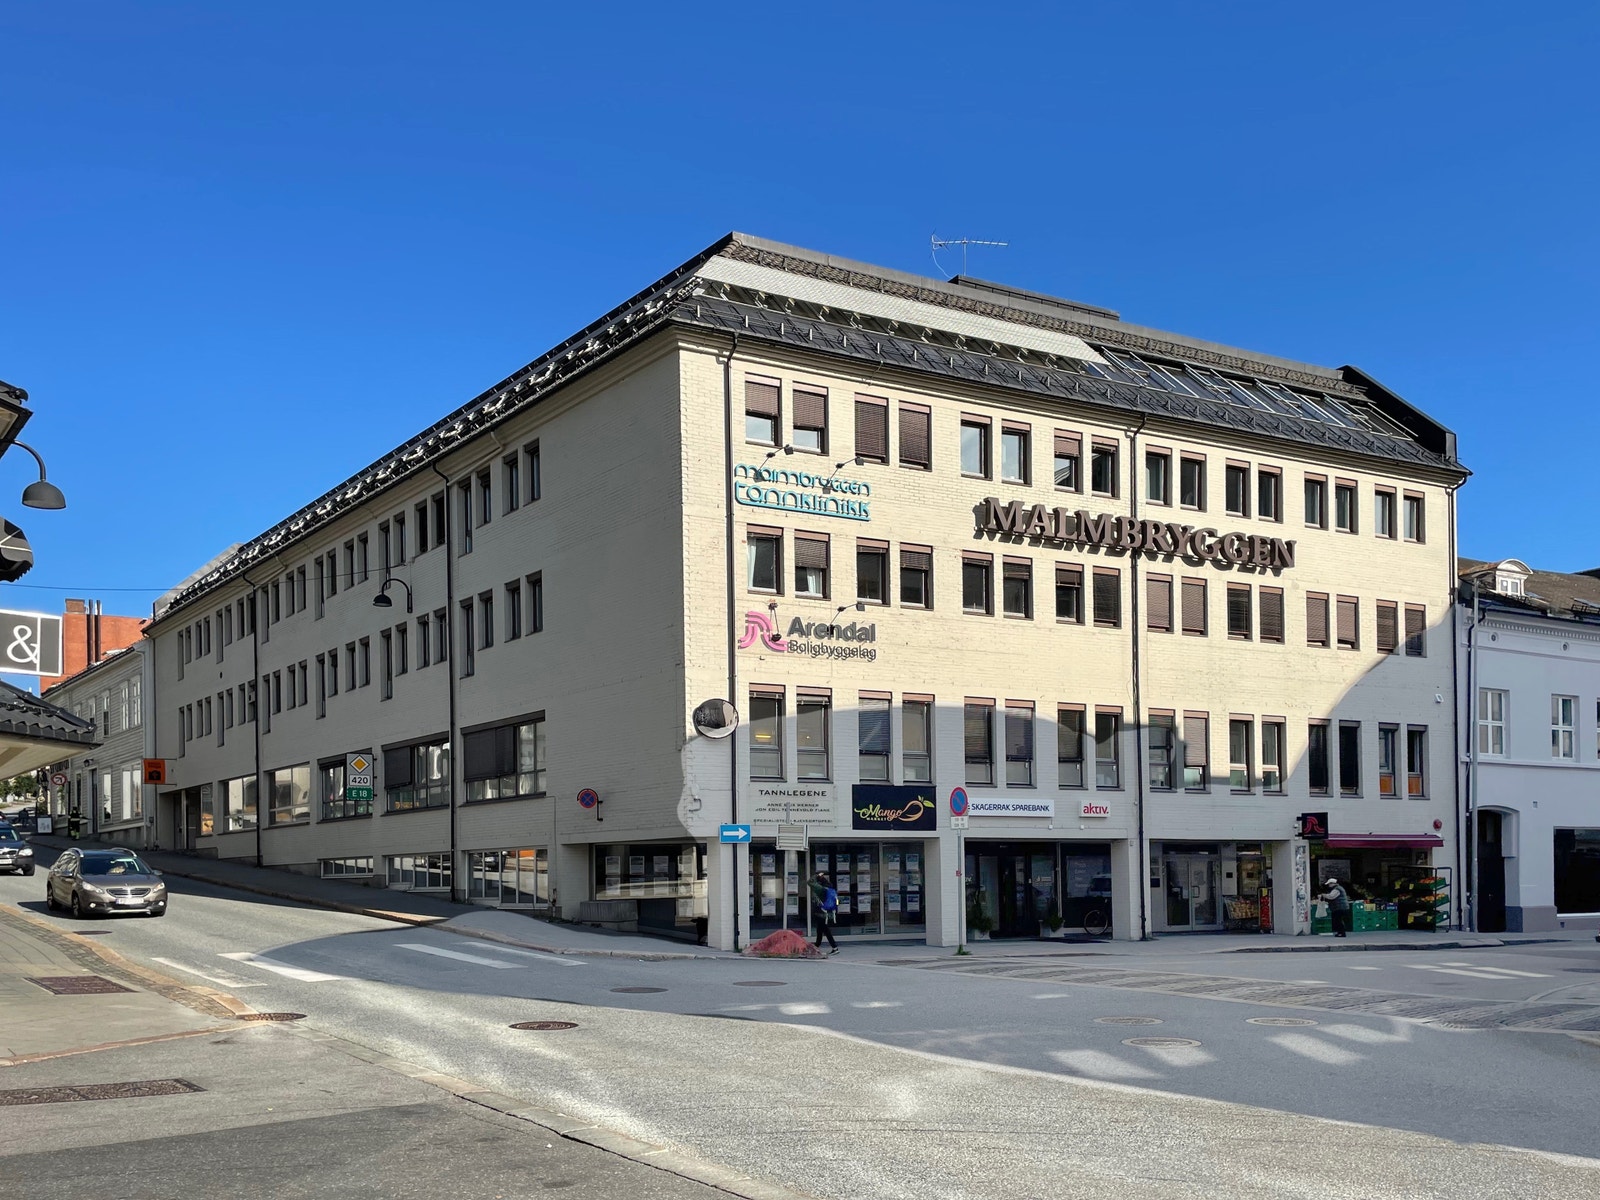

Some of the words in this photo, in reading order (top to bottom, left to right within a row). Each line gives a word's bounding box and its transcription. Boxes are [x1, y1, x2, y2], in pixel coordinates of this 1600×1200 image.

[983, 497, 1297, 569] MALMBRYGGEN
[786, 616, 876, 643] Arendal
[786, 639, 877, 662] Boligbyggelag
[758, 789, 827, 797] TANNLEGENE
[854, 804, 902, 821] Mango
[971, 803, 1011, 811] SKAGERRAK
[1011, 804, 1050, 812] SPAREBANK
